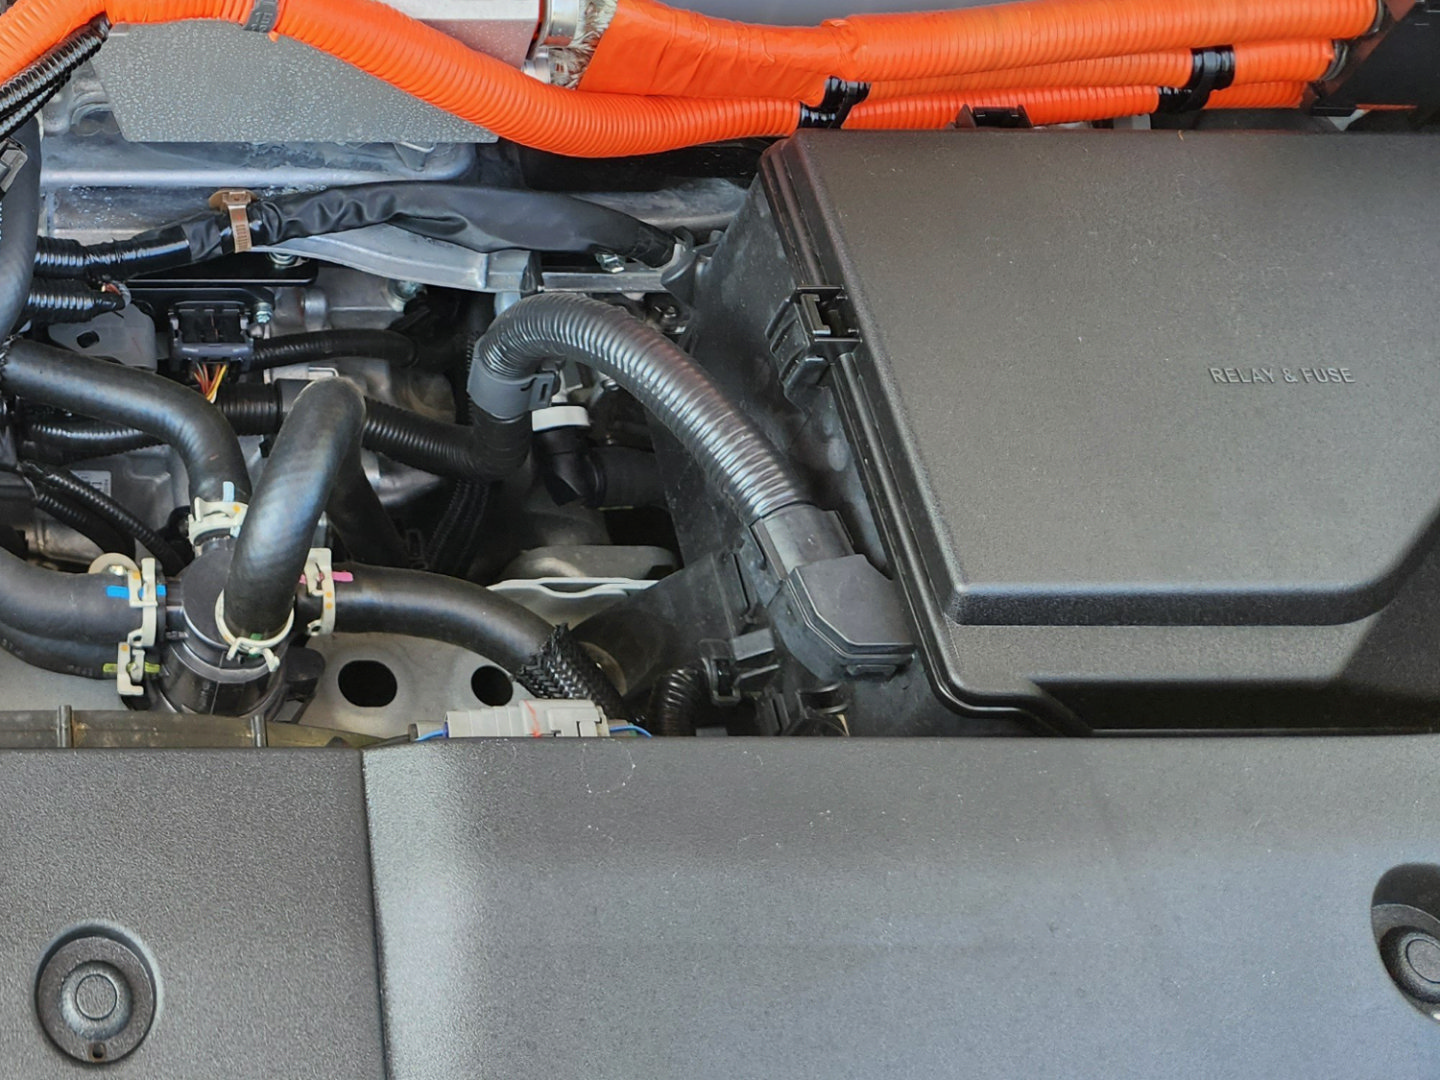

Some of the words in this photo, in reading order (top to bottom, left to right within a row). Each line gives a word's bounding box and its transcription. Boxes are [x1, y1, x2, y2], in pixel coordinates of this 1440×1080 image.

[1209, 367, 1276, 384] RELAY
[1282, 368, 1298, 383] &
[1300, 367, 1356, 384] FUSE
